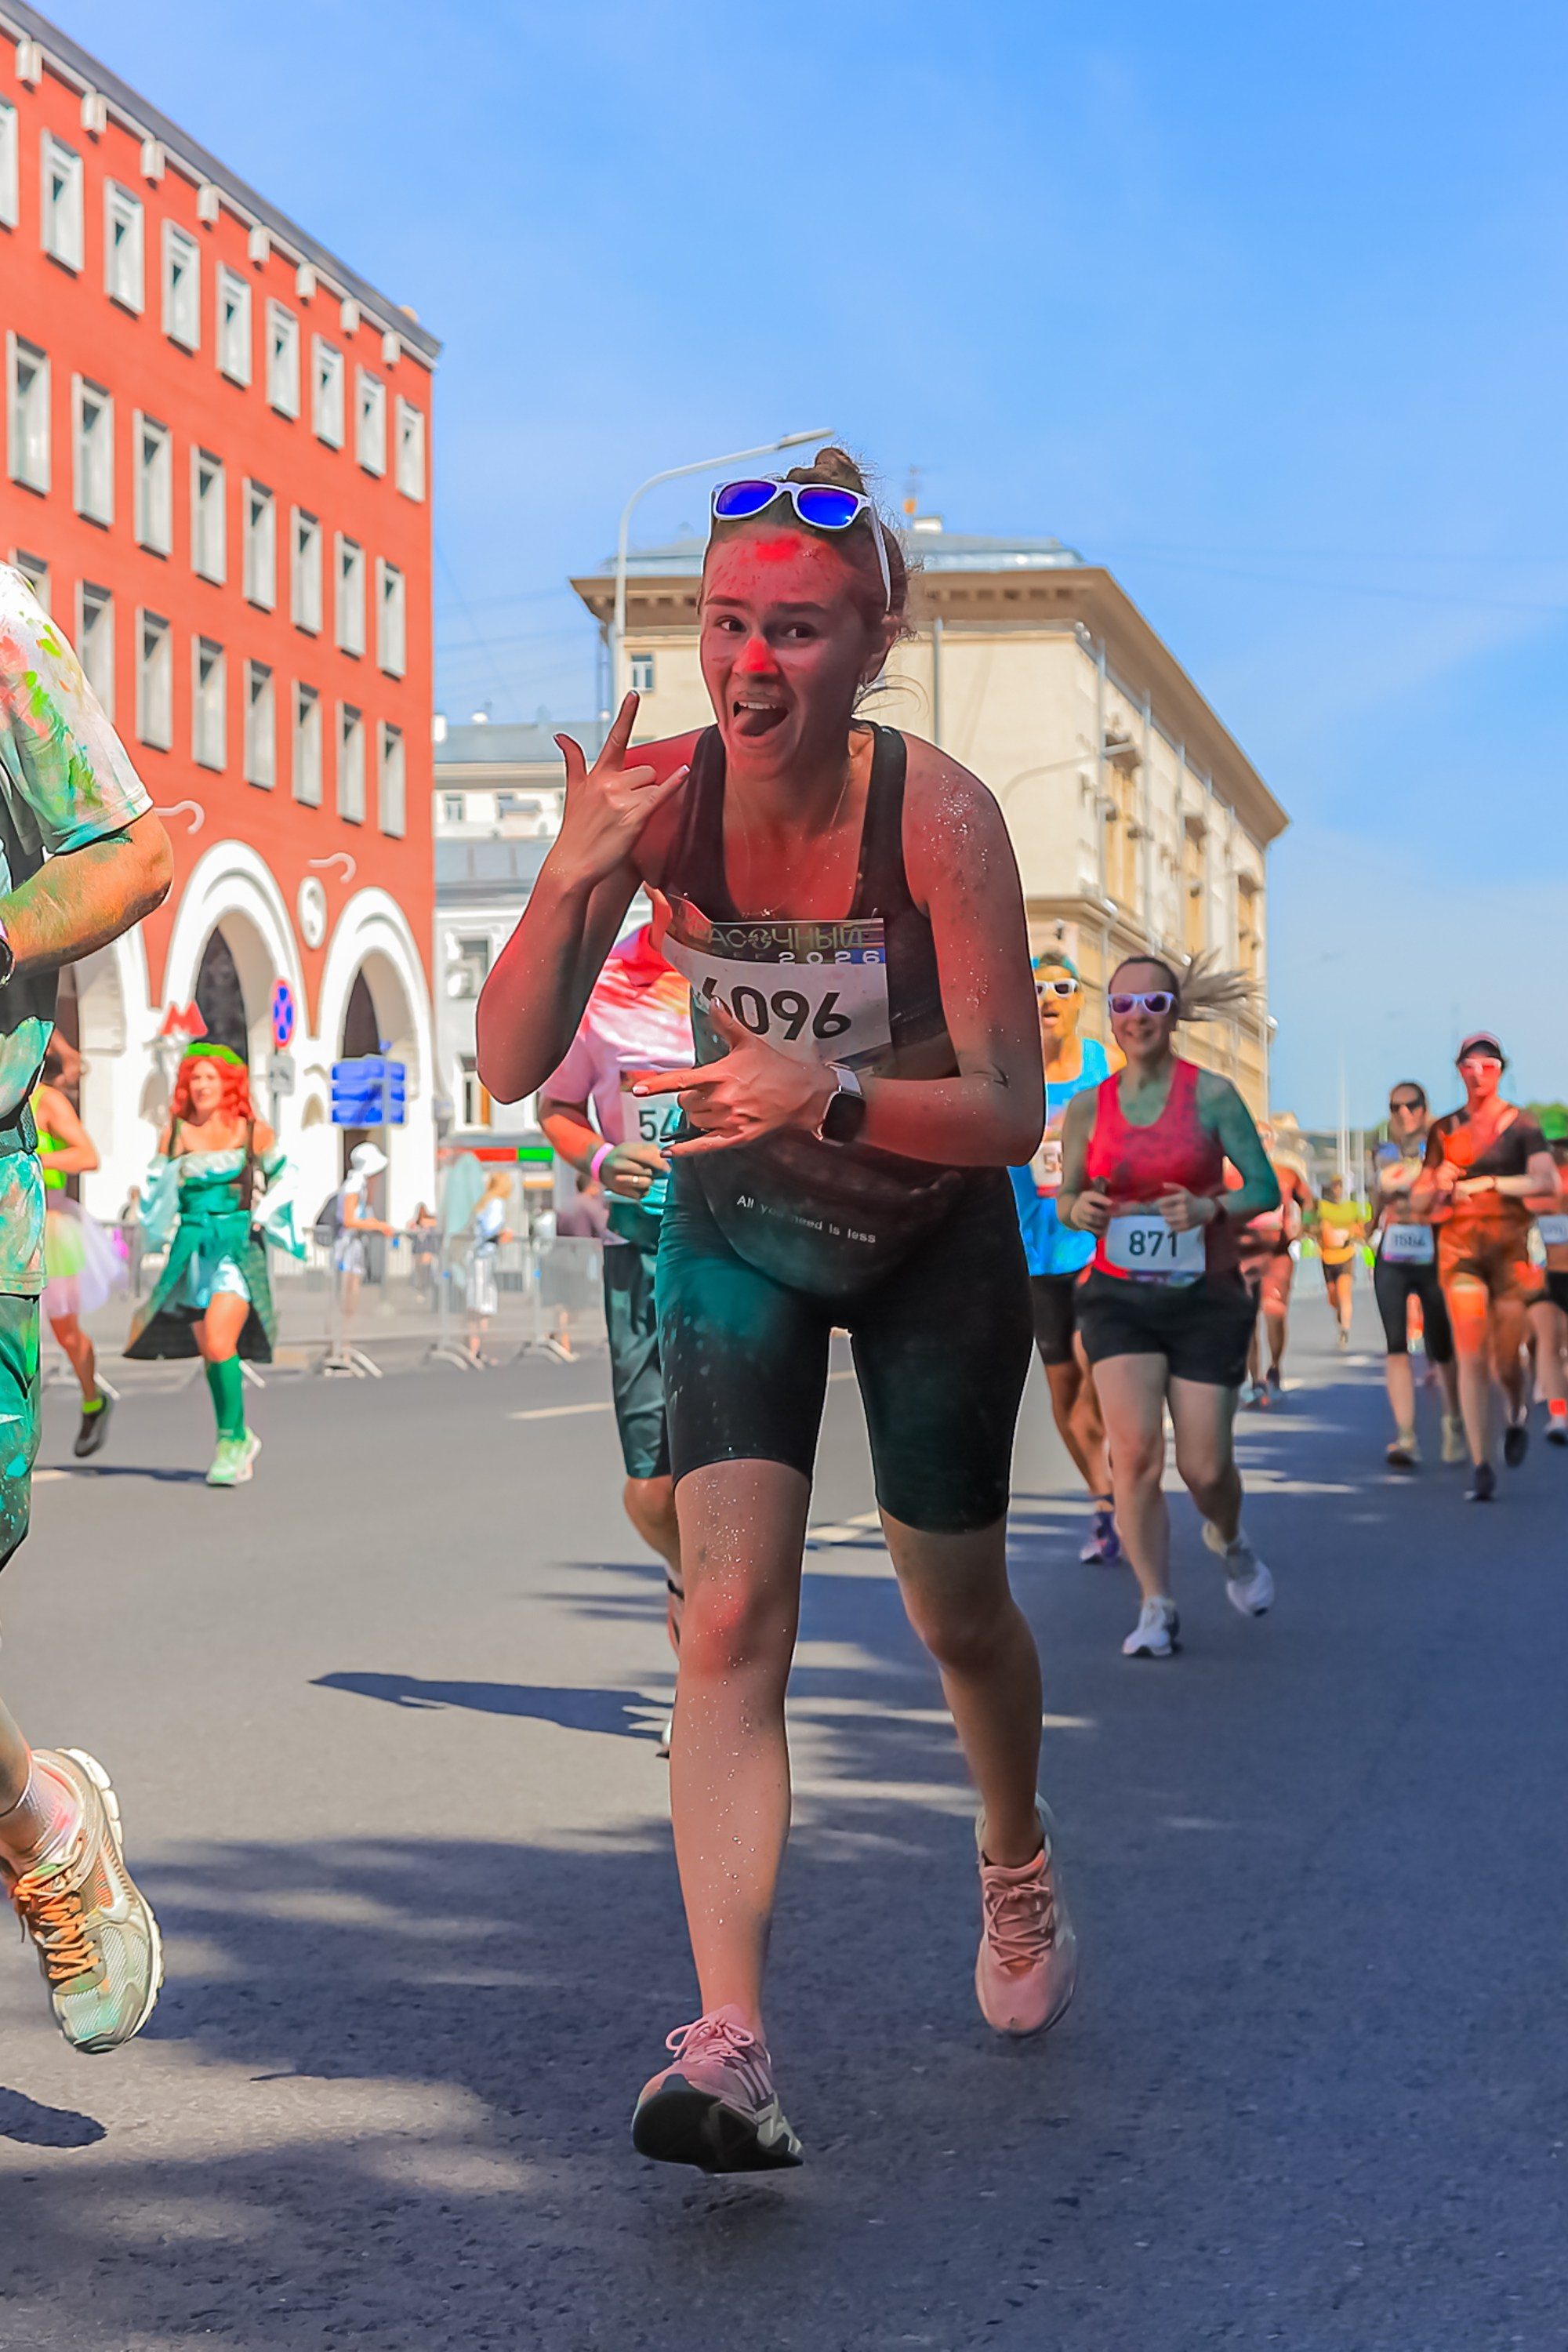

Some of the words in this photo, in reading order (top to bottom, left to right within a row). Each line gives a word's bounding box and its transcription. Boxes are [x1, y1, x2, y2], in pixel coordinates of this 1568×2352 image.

[778, 949, 880, 965] 2026
[736, 1195, 755, 1209] All
[790, 1214, 823, 1232] need
[848, 1229, 877, 1244] less
[1129, 1230, 1178, 1258] 871
